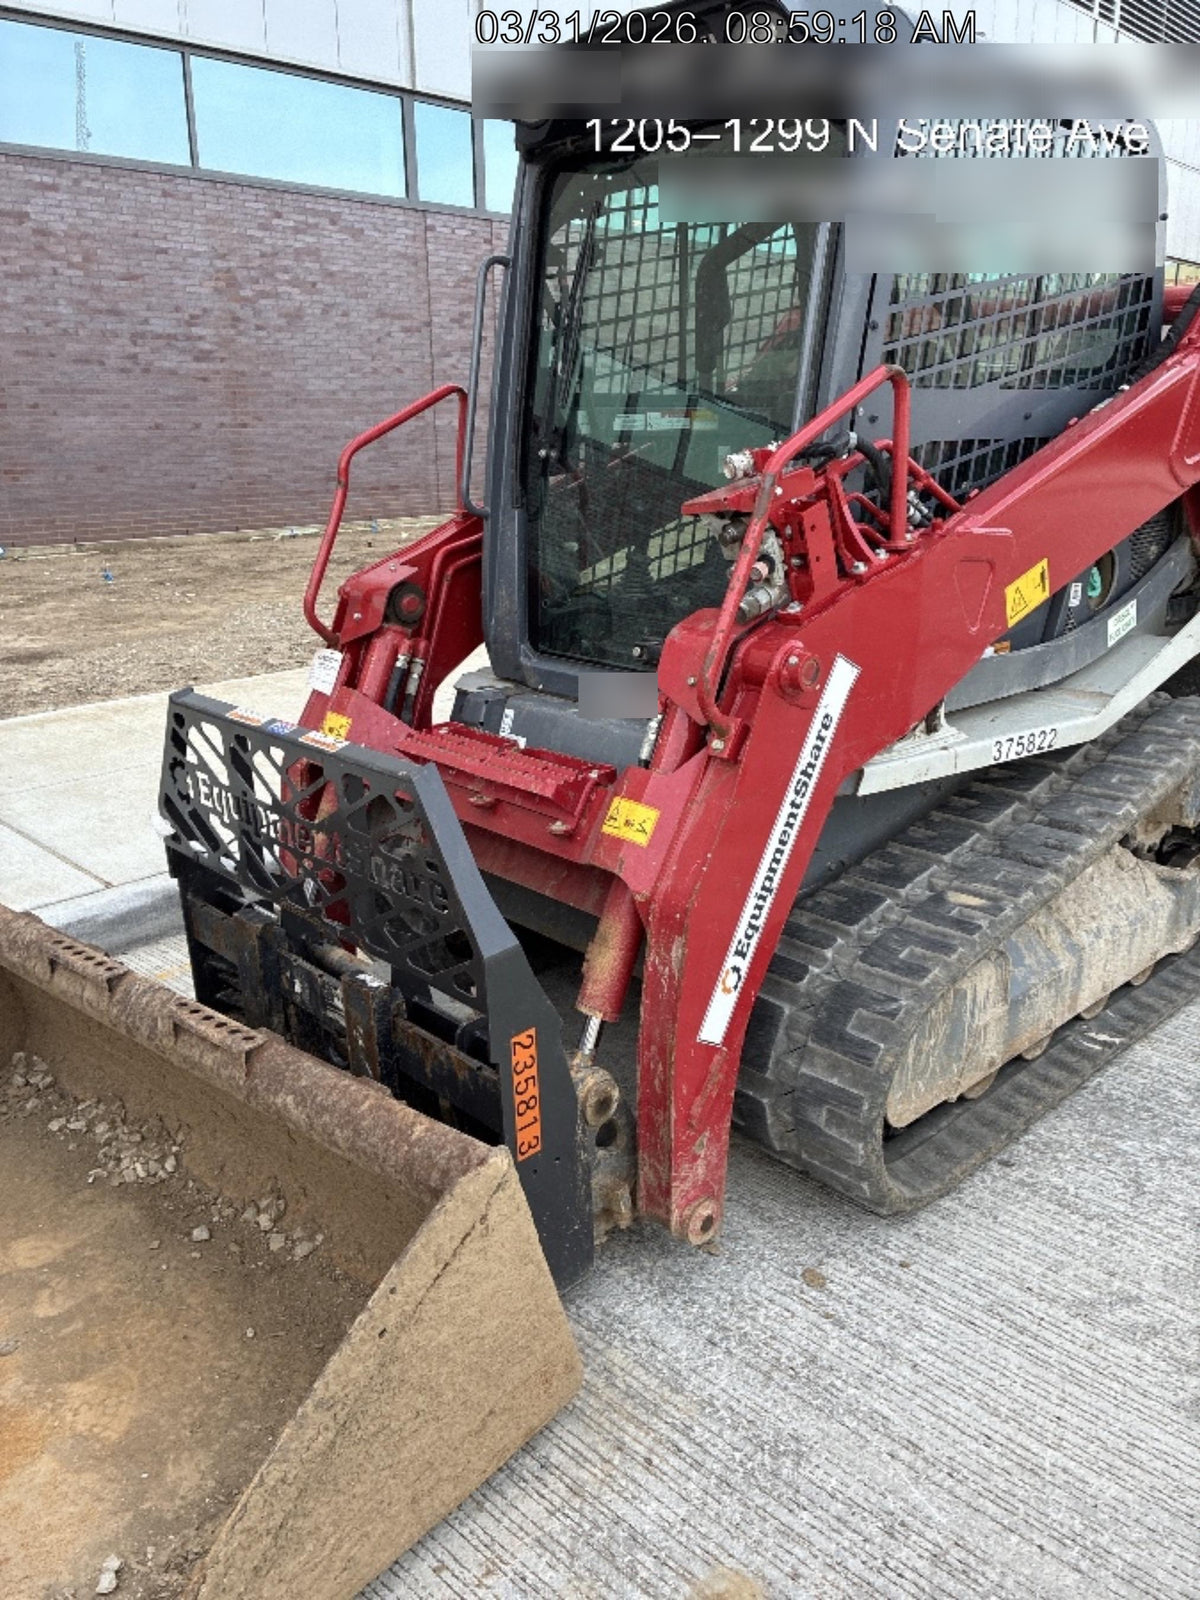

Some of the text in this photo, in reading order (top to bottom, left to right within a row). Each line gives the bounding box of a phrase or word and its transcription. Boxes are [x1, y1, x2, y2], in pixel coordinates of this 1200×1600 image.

[993, 728, 1057, 761] 375822
[733, 711, 833, 961] EquipmentShare
[511, 1033, 540, 1157] 235813
